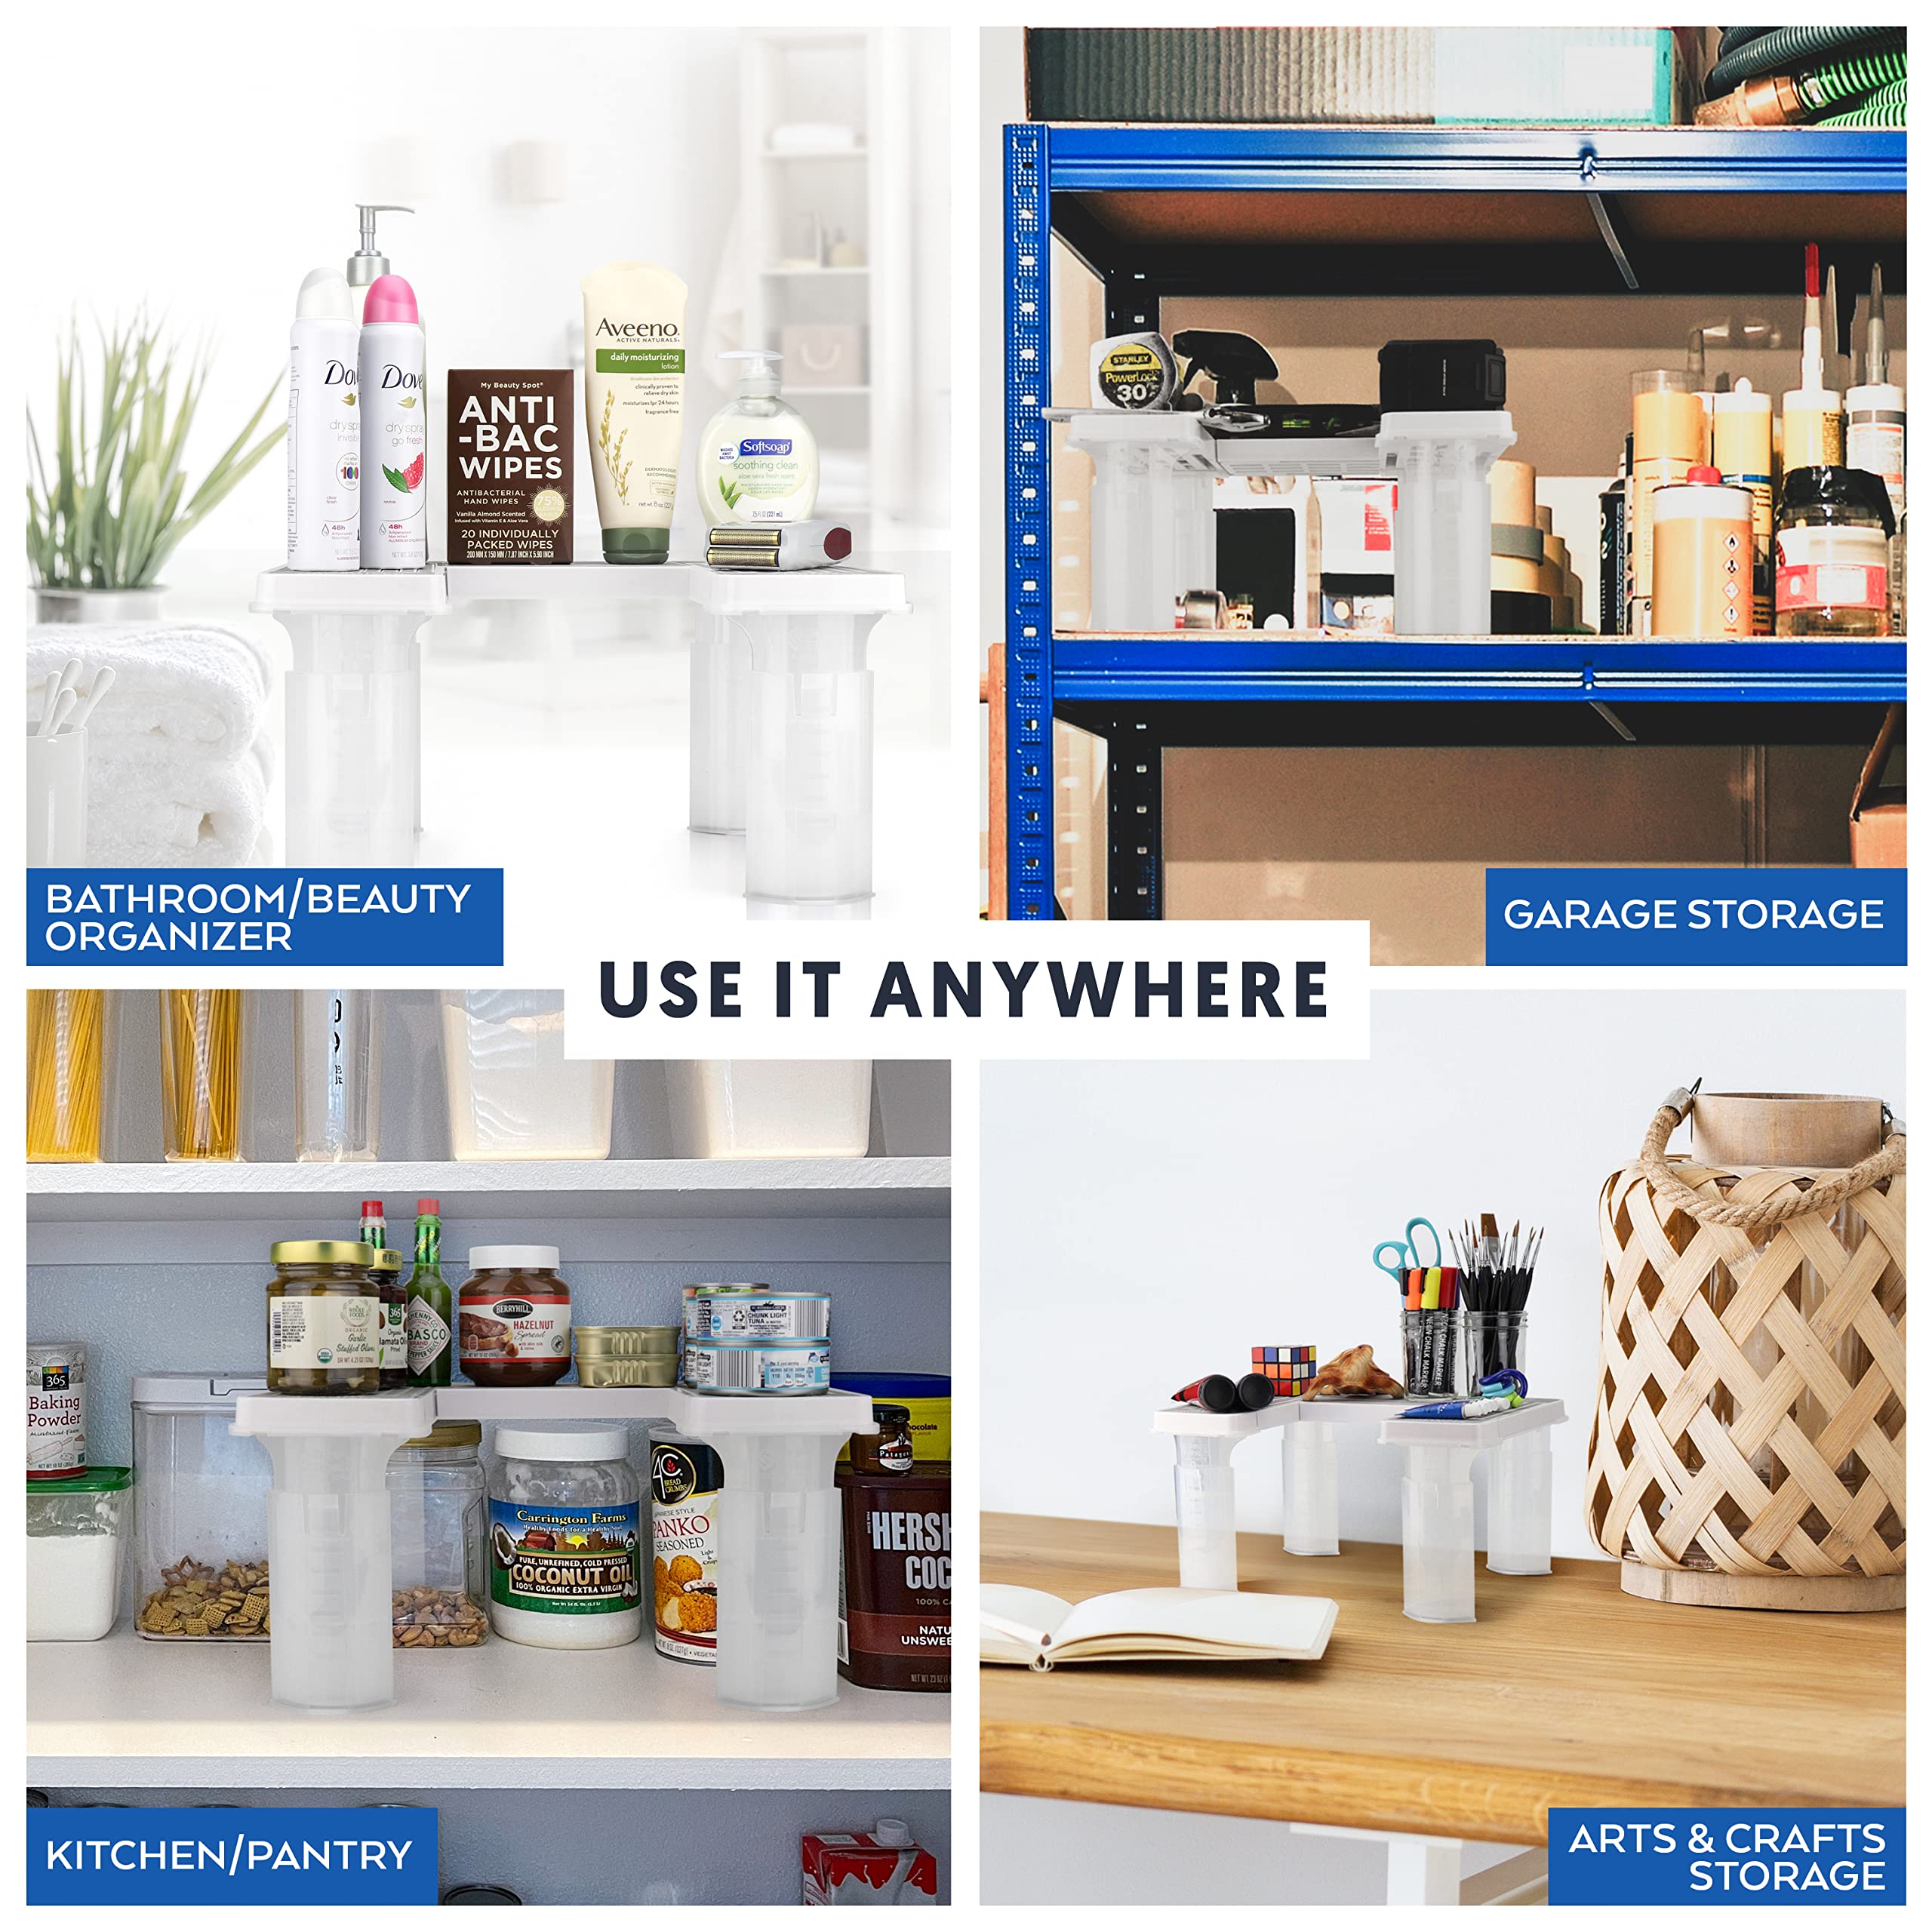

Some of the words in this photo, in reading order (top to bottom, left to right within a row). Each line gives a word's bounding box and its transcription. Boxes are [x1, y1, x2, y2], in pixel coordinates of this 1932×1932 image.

[595, 317, 678, 337] Aveeno
[611, 352, 629, 362] daily
[630, 352, 679, 362] moisturizing
[1113, 355, 1149, 364] STANLEY
[1106, 371, 1157, 383] PowerLock
[1117, 384, 1147, 401] 30
[459, 395, 554, 423] ANTI
[386, 423, 405, 435] dry
[392, 437, 405, 448] go
[406, 435, 423, 445] fresh
[459, 424, 559, 453] -BAC
[743, 440, 788, 454] Softsoap
[459, 457, 563, 479] WIPES
[733, 460, 774, 472] soothing
[776, 460, 798, 472] clean
[537, 496, 562, 506] 75%
[461, 530, 476, 539] 20
[478, 530, 559, 539] INDIVIDUALLY
[467, 540, 514, 549] PACKED
[517, 540, 553, 549] WIPES
[466, 550, 475, 558] 200
[488, 550, 497, 558] 150
[518, 550, 528, 558] INCH
[543, 550, 554, 558] INCH
[389, 1308, 401, 1318] 365
[496, 1305, 530, 1314] BERRYHILL
[513, 1320, 554, 1330] HAZELNUT
[348, 1334, 367, 1343] Garlic
[514, 1331, 545, 1341] Spread
[336, 1343, 358, 1353] Stuffed
[360, 1343, 375, 1353] Olives
[410, 1349, 428, 1358] PEPPER
[428, 1340, 439, 1354] SAUCE
[1423, 1336, 1432, 1358] CHALK
[1438, 1334, 1447, 1356] CHALK
[1420, 1359, 1430, 1389] MARKER
[1435, 1358, 1444, 1387] MARKER
[46, 1374, 66, 1387] 365
[29, 1395, 80, 1411] Baking
[27, 1411, 82, 1427] Powder
[652, 1454, 681, 1500] 4C
[664, 1478, 681, 1487] BREAD
[665, 1484, 688, 1494] CRUMBS
[675, 1507, 695, 1515] STYLE
[517, 1510, 588, 1525] Carrington
[592, 1512, 626, 1524] Farms
[652, 1515, 710, 1539] PANKO
[656, 1537, 704, 1552] SEASONED
[538, 1558, 583, 1567] UNREFINED,
[583, 1558, 602, 1567] COLD
[604, 1557, 628, 1566] PRESSED
[512, 1564, 604, 1586] COCONUT
[610, 1564, 632, 1584] OIL
[516, 1582, 534, 1591] 100%
[535, 1584, 570, 1594] ORGANIC
[573, 1585, 598, 1594] EXTRA
[600, 1583, 623, 1593] VIRGIN
